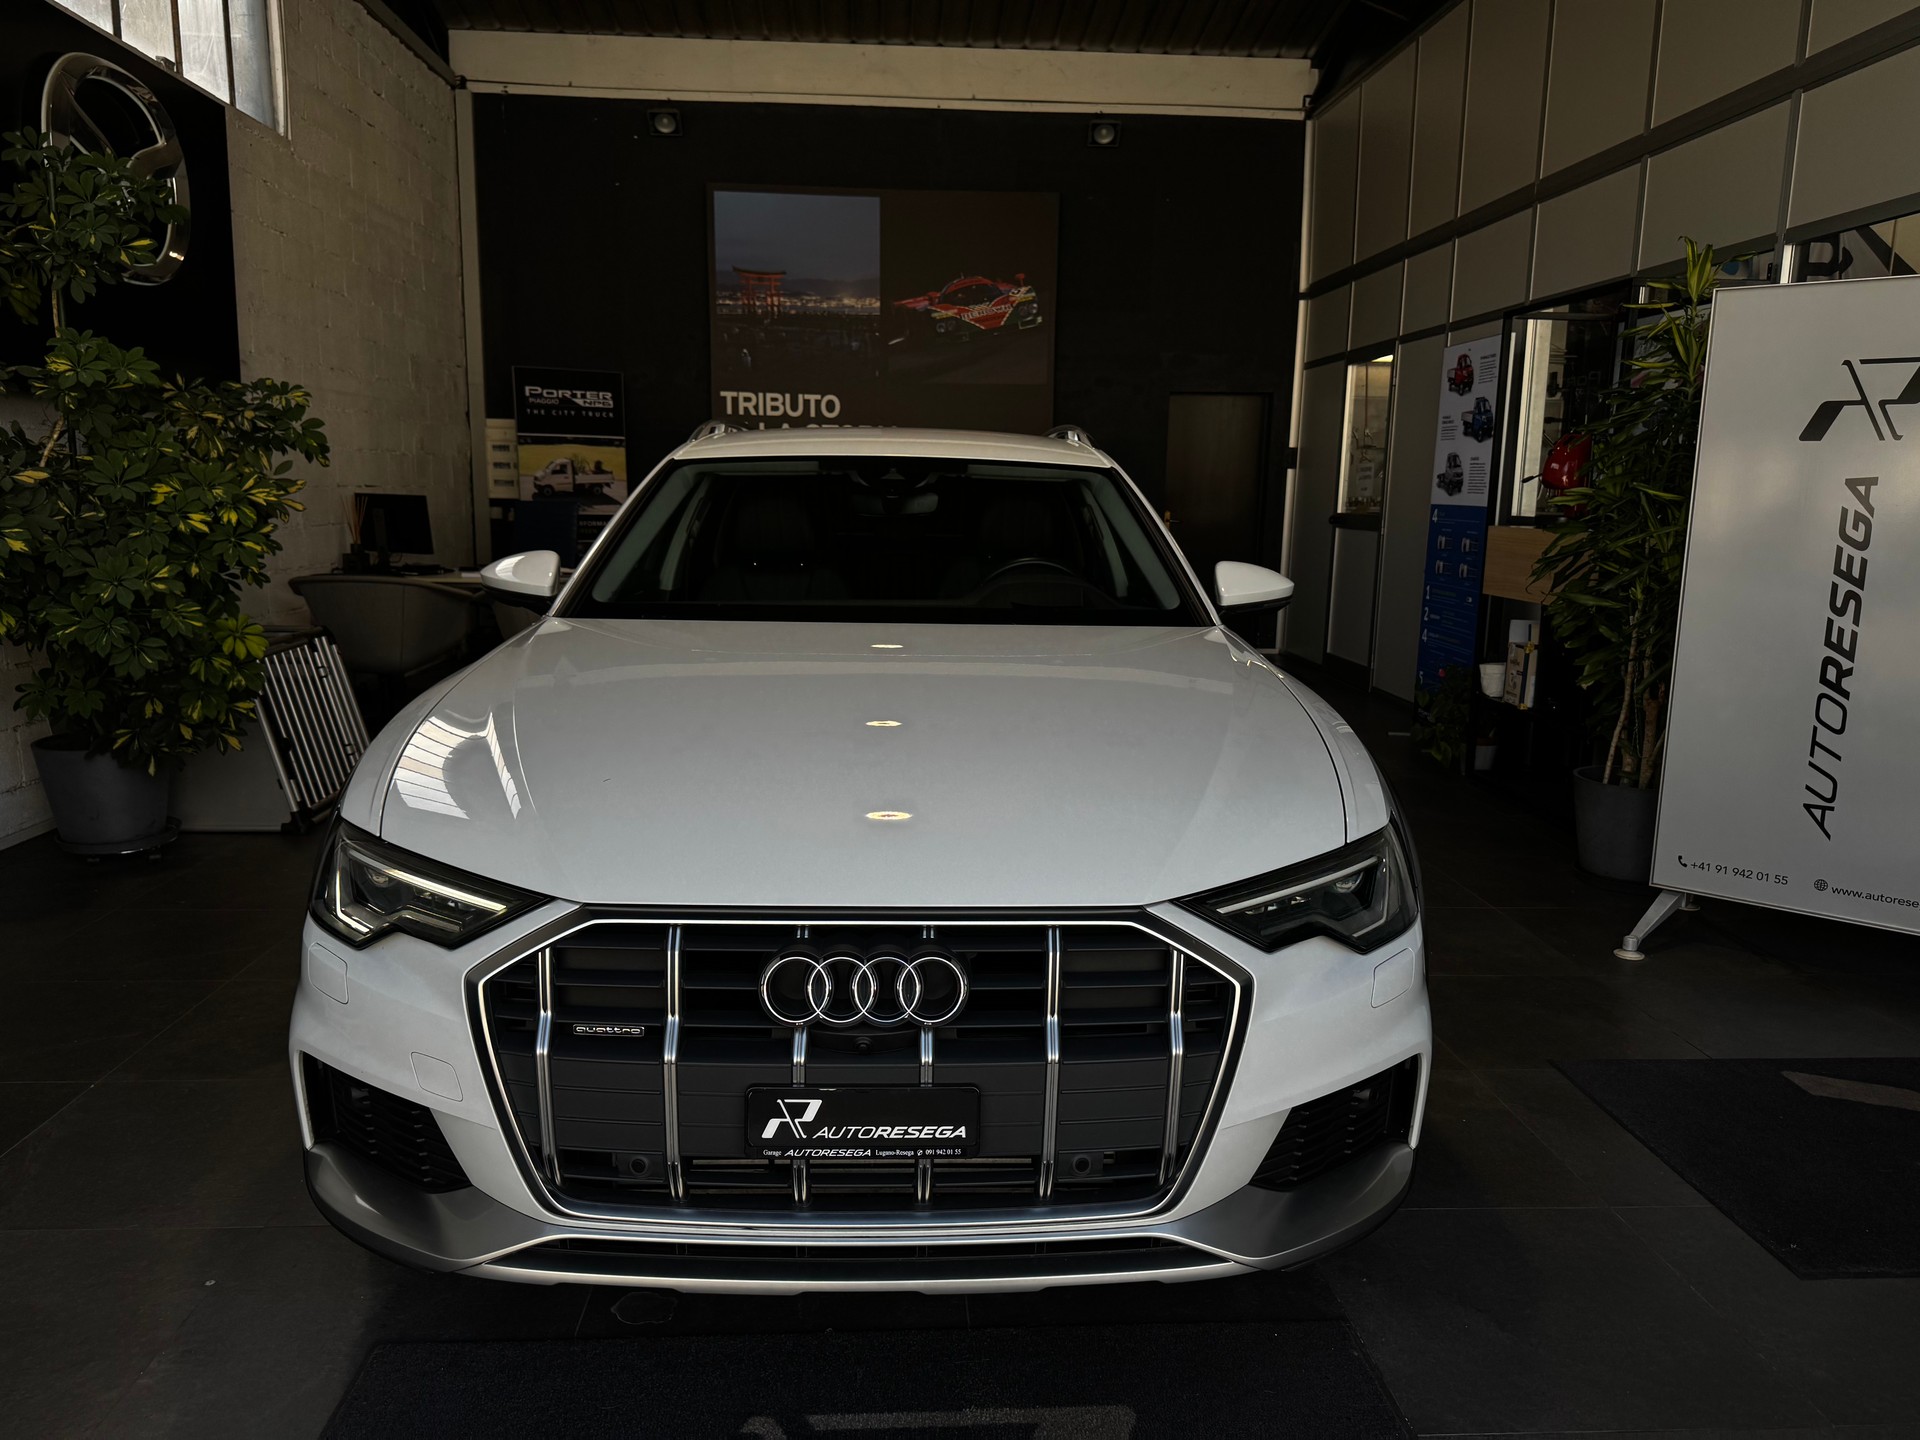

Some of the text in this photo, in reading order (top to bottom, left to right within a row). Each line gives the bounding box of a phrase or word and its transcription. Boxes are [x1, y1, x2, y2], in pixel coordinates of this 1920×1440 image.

[524, 385, 613, 401] PORTER
[720, 391, 841, 418] TRIBUTO
[526, 408, 614, 418] THE CITY TRUCK
[1802, 476, 1879, 841] AUTORESEGA
[1690, 862, 1789, 886] +41 91 942 01 55
[1831, 886, 1920, 911] www.autorese
[575, 1026, 641, 1035] quattro
[812, 1125, 967, 1139] AUTORESEGA
[762, 1149, 782, 1158] Garage
[784, 1148, 872, 1157] AUTORESEGA
[925, 1148, 935, 1156] 091
[935, 1148, 947, 1156] 942
[946, 1148, 954, 1156] 01
[954, 1148, 962, 1156] 55
